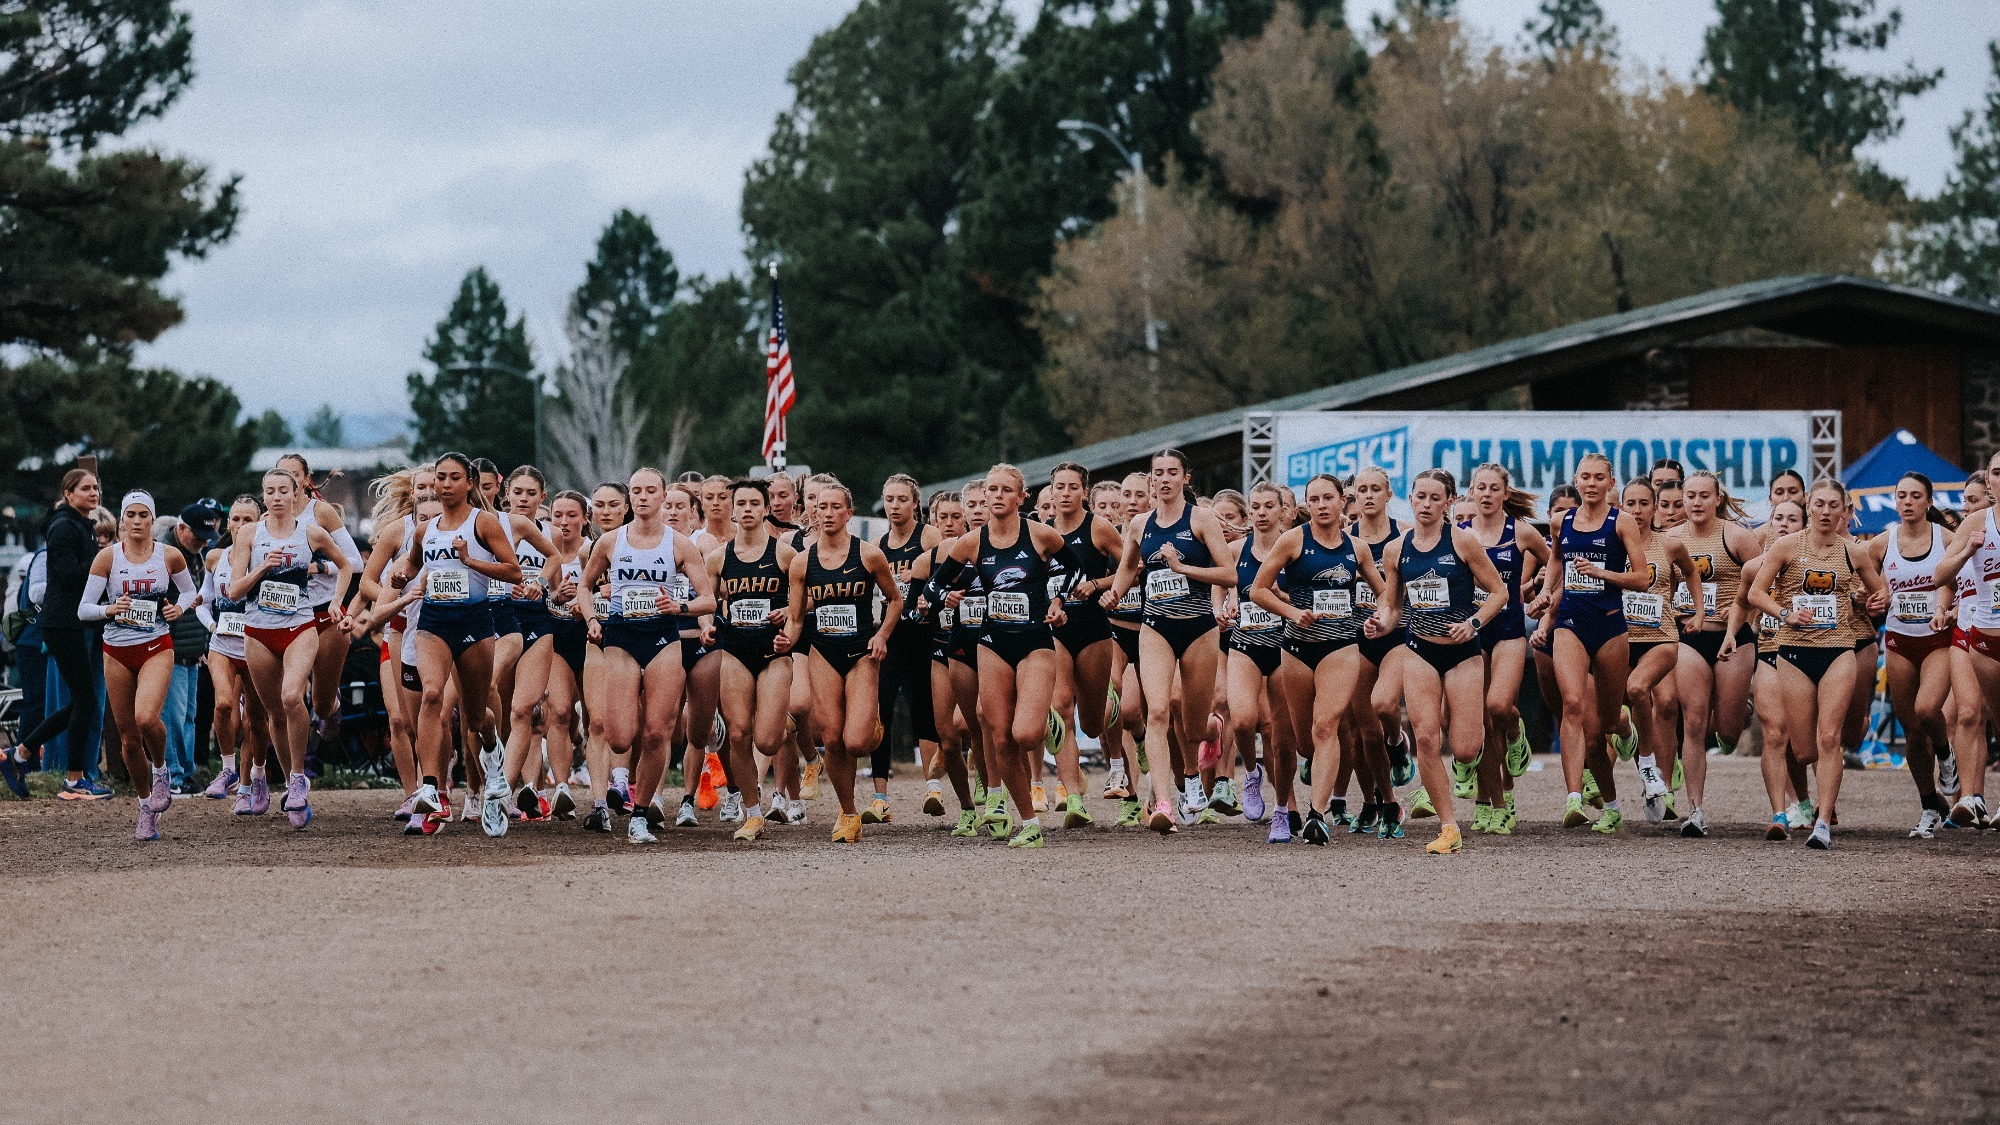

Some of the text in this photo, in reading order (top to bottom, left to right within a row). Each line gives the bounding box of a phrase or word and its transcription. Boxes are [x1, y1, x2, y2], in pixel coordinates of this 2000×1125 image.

[1563, 551, 1607, 561] WEBER STATE
[617, 568, 668, 583] NAU
[433, 580, 462, 593] BURNS
[1151, 577, 1183, 593] MOTLEY
[261, 590, 297, 605] PERRITON
[1417, 590, 1439, 602] KAUL
[737, 608, 763, 621] TERRY
[992, 601, 1025, 615] HACKER
[1626, 602, 1656, 617] STROIA
[1899, 602, 1928, 614] MEYER
[819, 615, 854, 628] REDDING
[1250, 611, 1272, 624] KOOS
